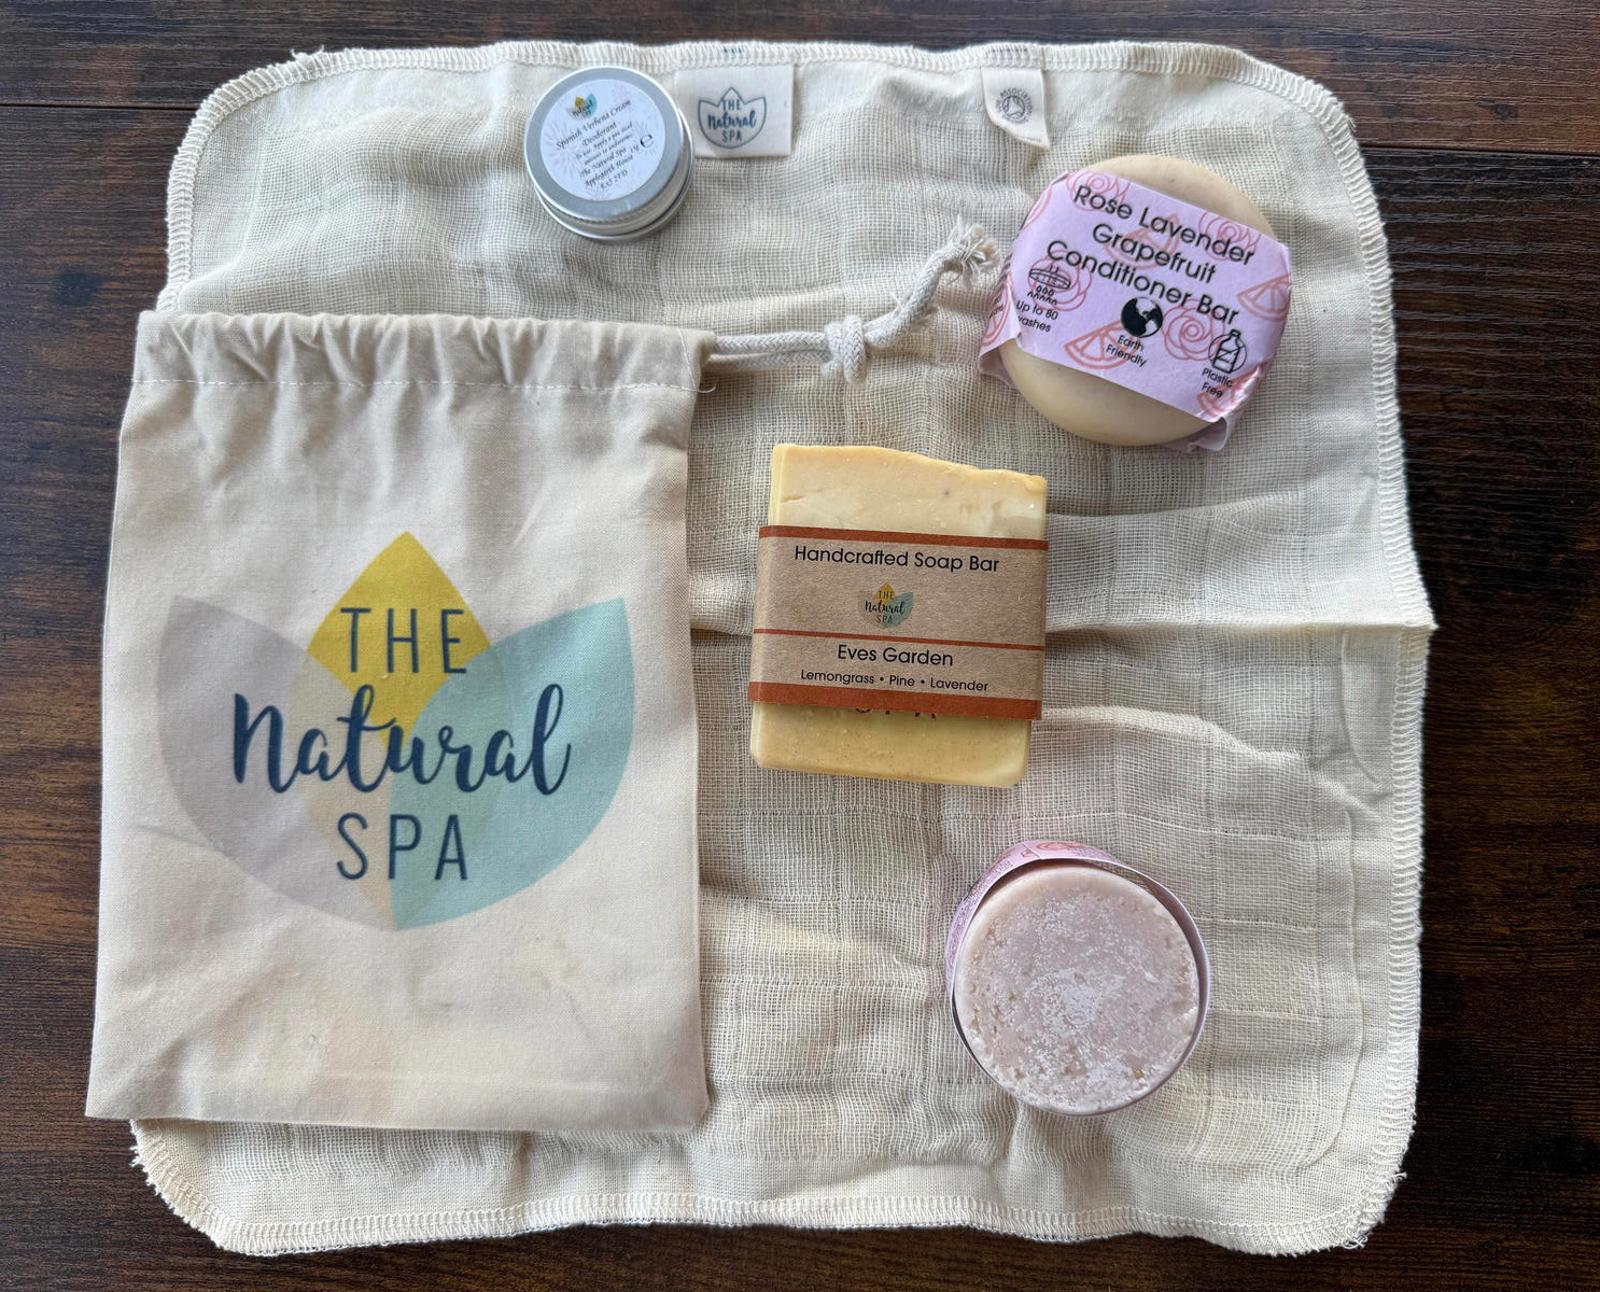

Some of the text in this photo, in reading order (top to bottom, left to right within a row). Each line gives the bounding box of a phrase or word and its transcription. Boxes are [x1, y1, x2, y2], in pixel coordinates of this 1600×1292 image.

[722, 99, 741, 111] THE
[556, 127, 582, 150] Spanish
[610, 100, 631, 116] Cream
[582, 121, 617, 146] Deodorant
[722, 131, 742, 143] SPA
[615, 146, 627, 159] Spa
[1072, 185, 1255, 266] Rose Lavender
[1092, 223, 1217, 284] Grapefruit
[1047, 240, 1239, 325] Conditioner Bar
[1016, 300, 1030, 313] Up
[1032, 303, 1043, 315] to
[1117, 333, 1145, 352] Earth
[1105, 343, 1149, 369] Friendly
[1201, 367, 1233, 388] Plastic
[1201, 382, 1224, 399] Free
[794, 544, 1000, 573] Handcrafted Soap Bar
[878, 590, 894, 600] THE
[876, 614, 894, 624] SPA
[340, 607, 468, 674] THE
[837, 644, 954, 667] Eves Garden
[800, 669, 989, 693] Lemongrass Pine Lavender
[233, 683, 572, 796] Natural
[336, 811, 468, 881] SPA
